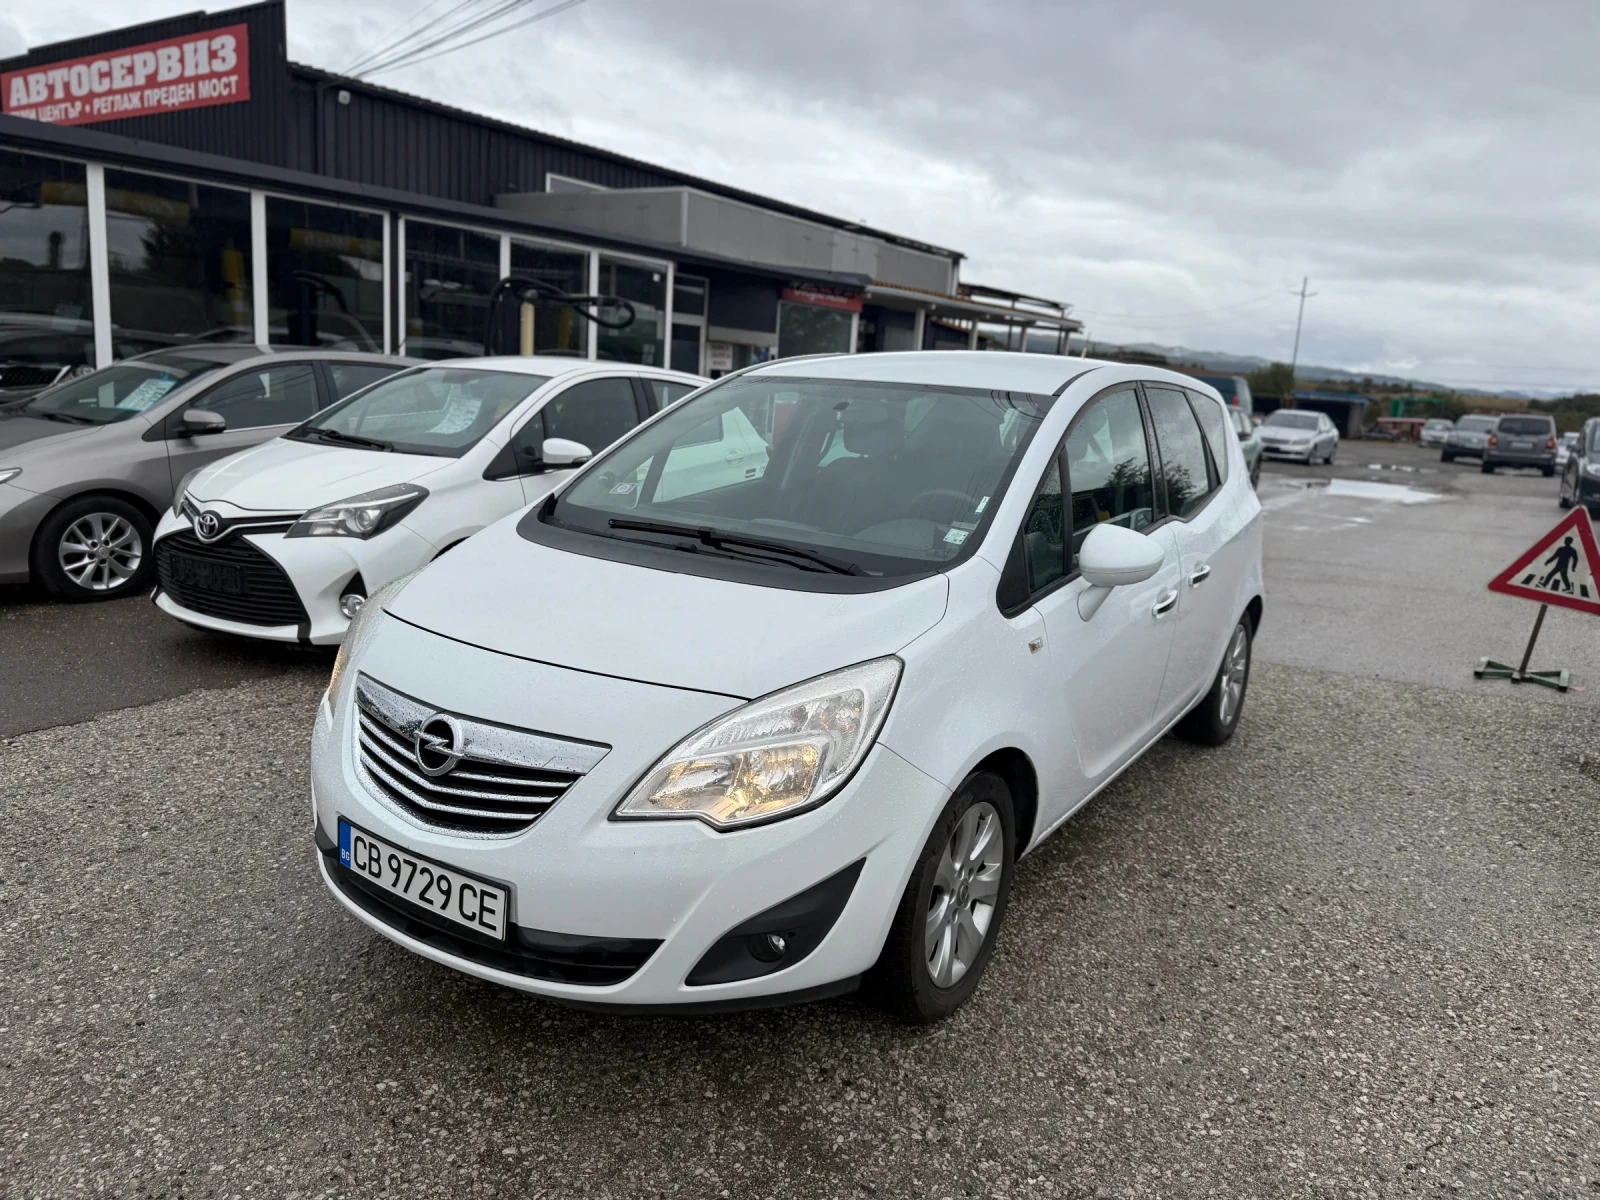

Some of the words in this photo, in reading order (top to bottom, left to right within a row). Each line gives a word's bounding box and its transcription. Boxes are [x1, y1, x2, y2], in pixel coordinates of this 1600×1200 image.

[9, 34, 238, 107] АВТОСЕРВИЗ
[38, 100, 82, 123] ЦЕНТЪР
[93, 91, 142, 116] РЕГЛАЖ
[143, 83, 196, 108] ПРЕДЕН
[198, 75, 239, 99] МОСТ
[341, 848, 350, 861] BG
[353, 835, 383, 879] CB
[387, 853, 453, 911] 9729
[458, 883, 498, 932] CE
